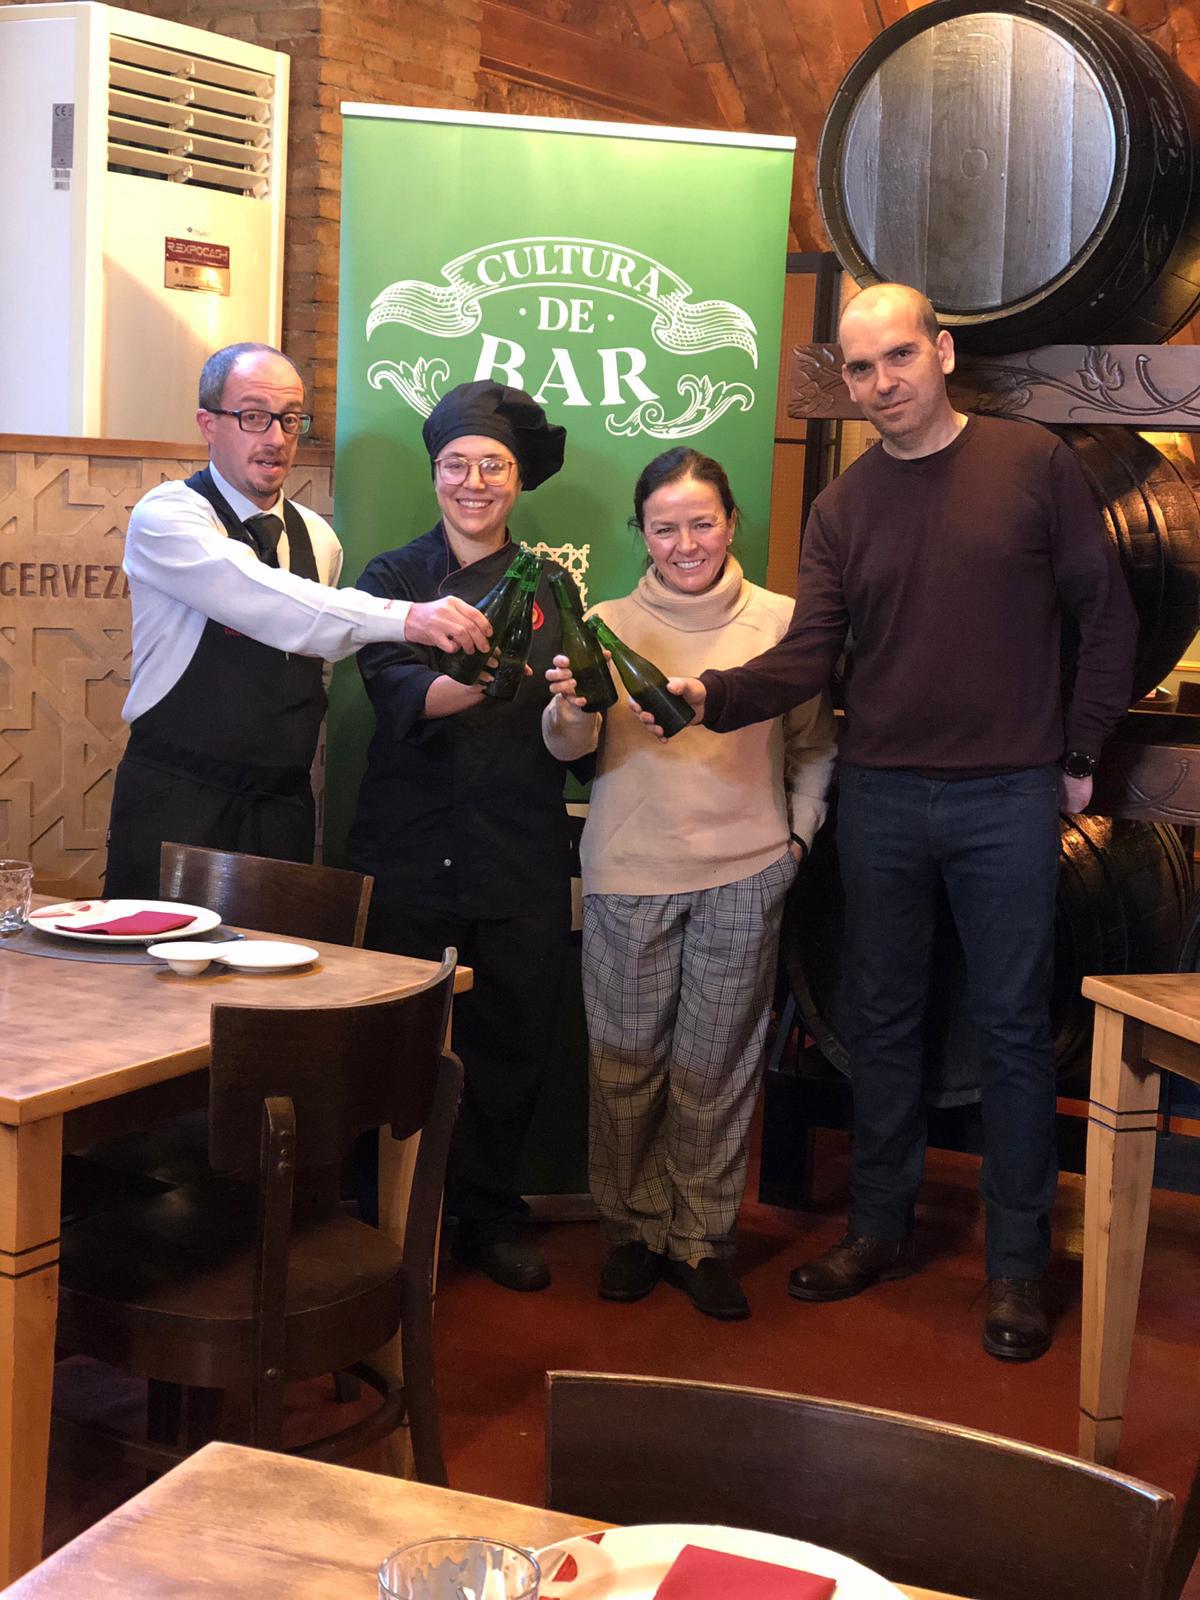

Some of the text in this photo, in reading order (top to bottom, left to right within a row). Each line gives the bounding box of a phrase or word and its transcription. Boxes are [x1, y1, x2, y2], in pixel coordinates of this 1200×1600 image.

[477, 244, 660, 300] CULTURA
[537, 296, 594, 333] DE
[472, 332, 661, 407] BAR
